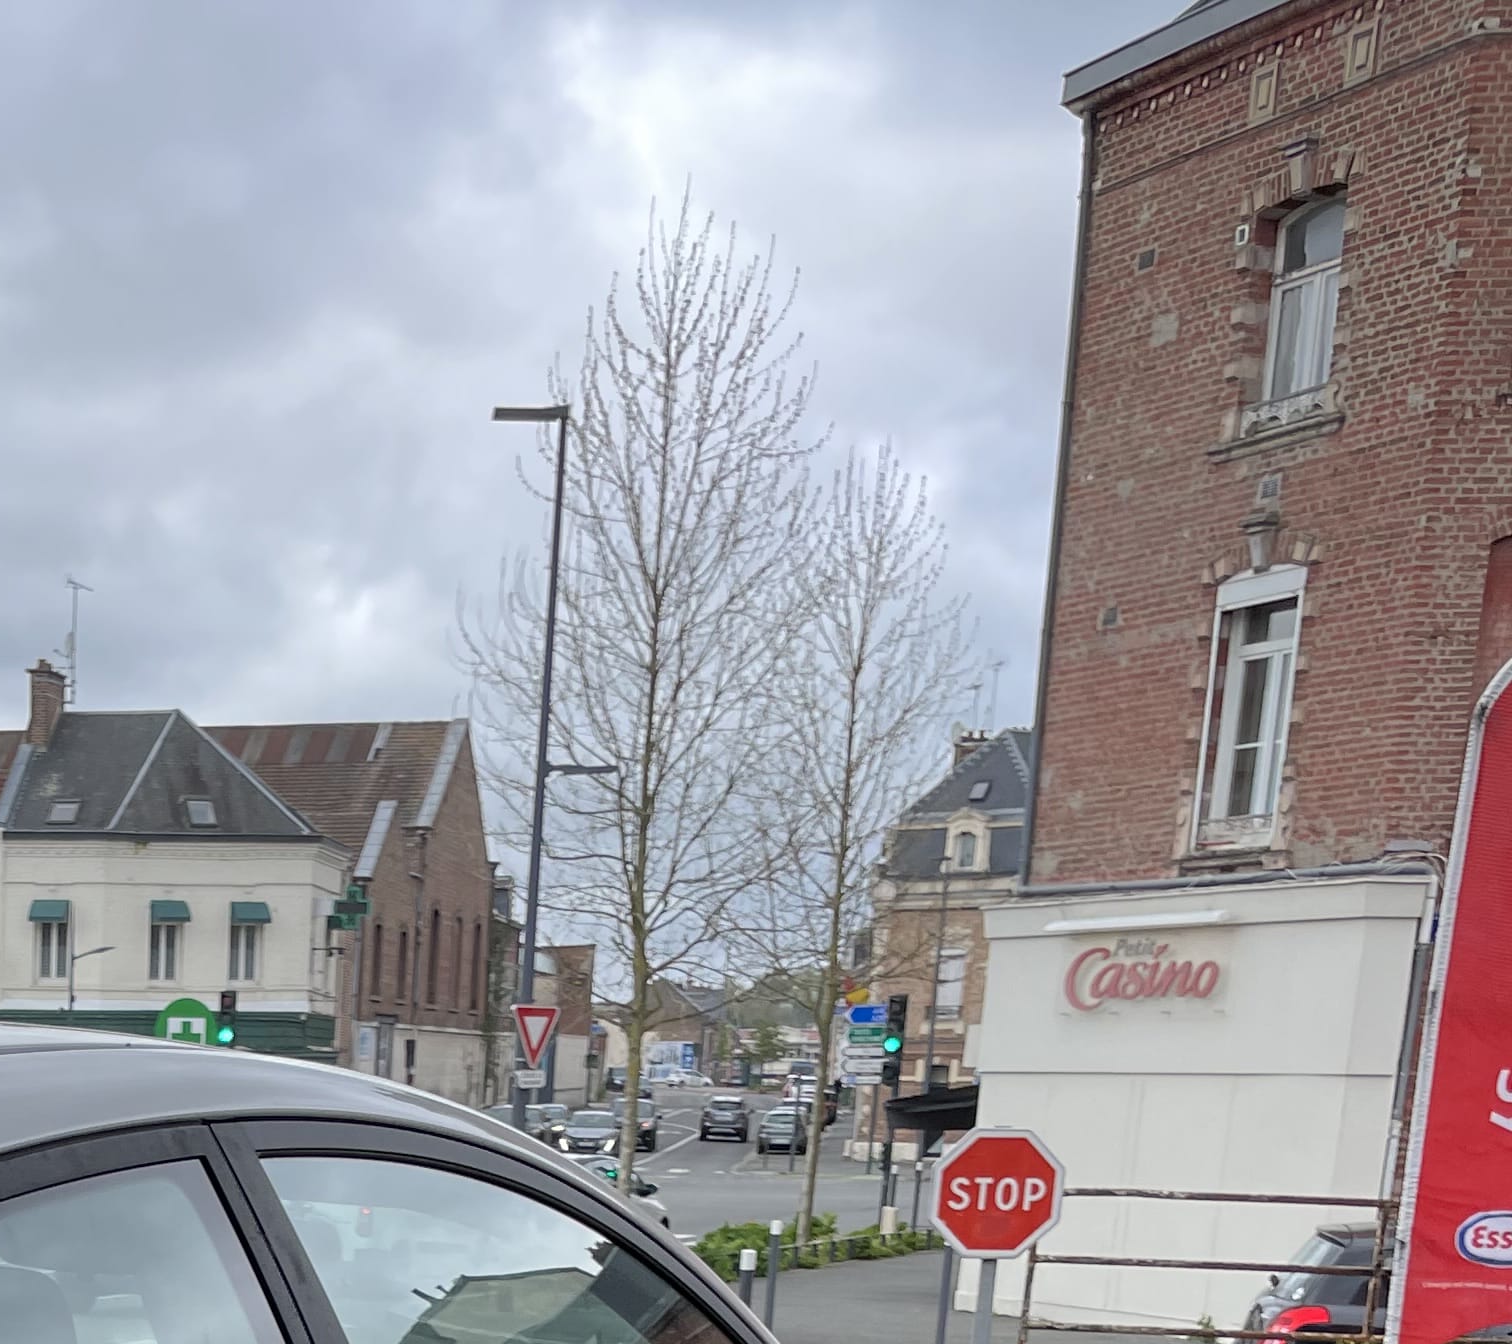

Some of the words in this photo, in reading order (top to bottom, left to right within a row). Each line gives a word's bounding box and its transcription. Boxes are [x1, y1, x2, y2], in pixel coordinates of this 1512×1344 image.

[1114, 937, 1158, 957] Petit
[1065, 943, 1221, 1012] Casino
[946, 1176, 1047, 1212] STOP
